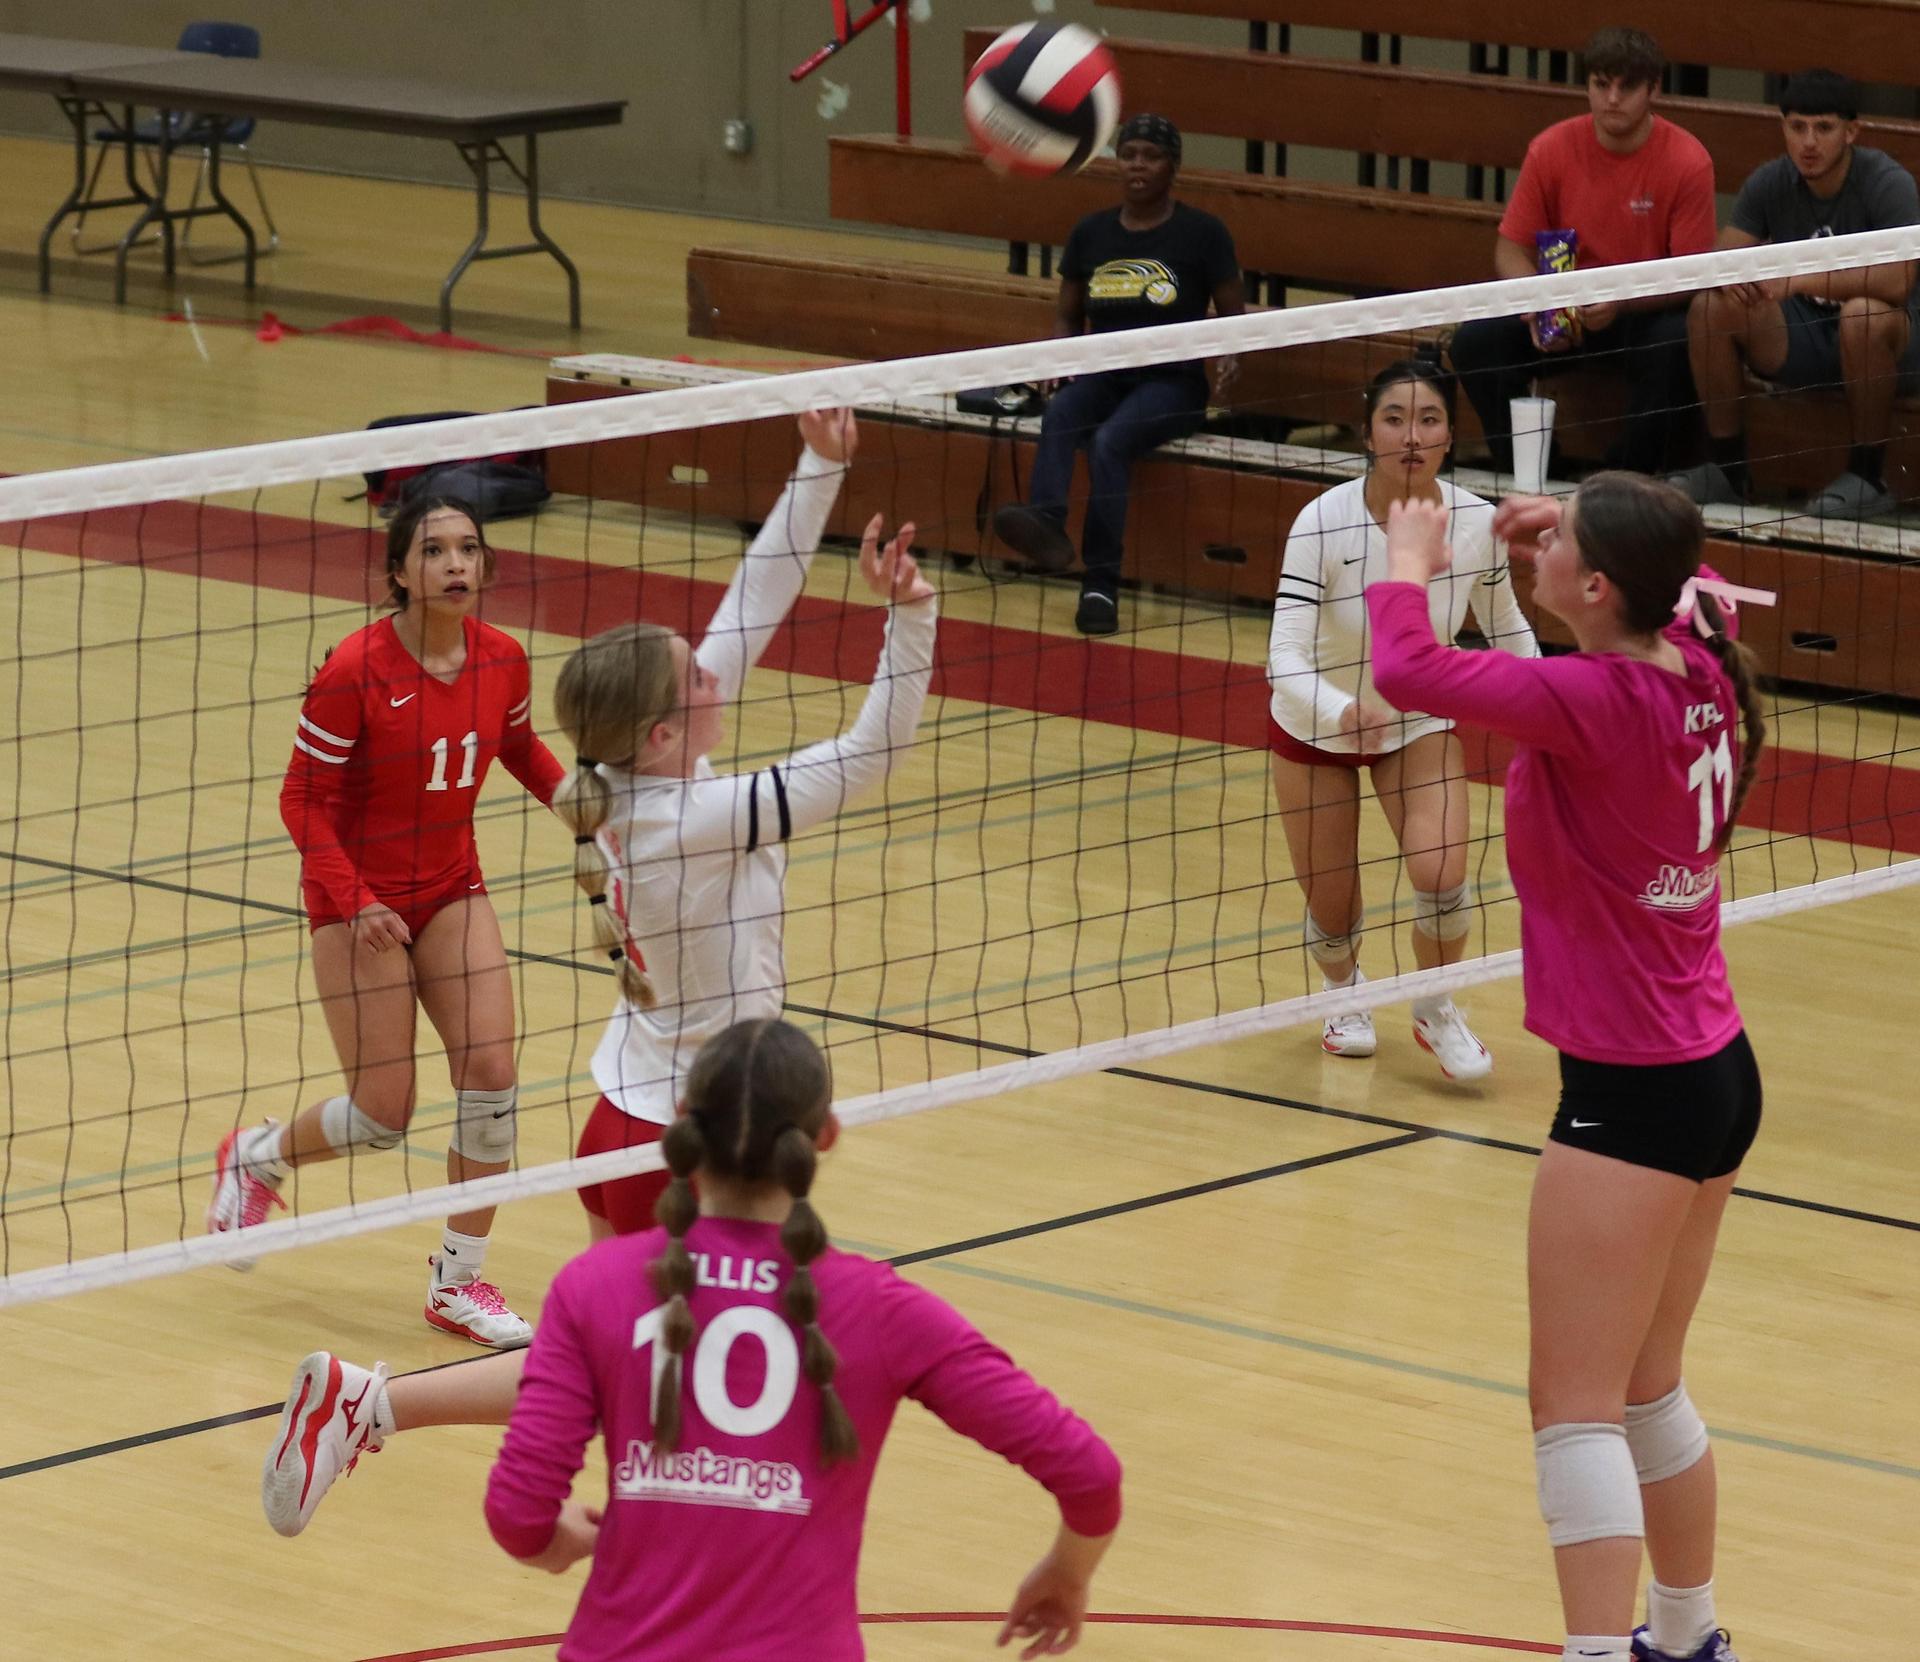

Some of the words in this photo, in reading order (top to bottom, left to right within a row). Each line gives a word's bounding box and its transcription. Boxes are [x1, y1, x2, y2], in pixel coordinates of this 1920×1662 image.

[425, 730, 478, 791] 11
[1688, 728, 1734, 854] 11
[688, 1251, 781, 1294] LLIS
[632, 1301, 800, 1437] 10
[617, 1440, 797, 1500] Mustangs
